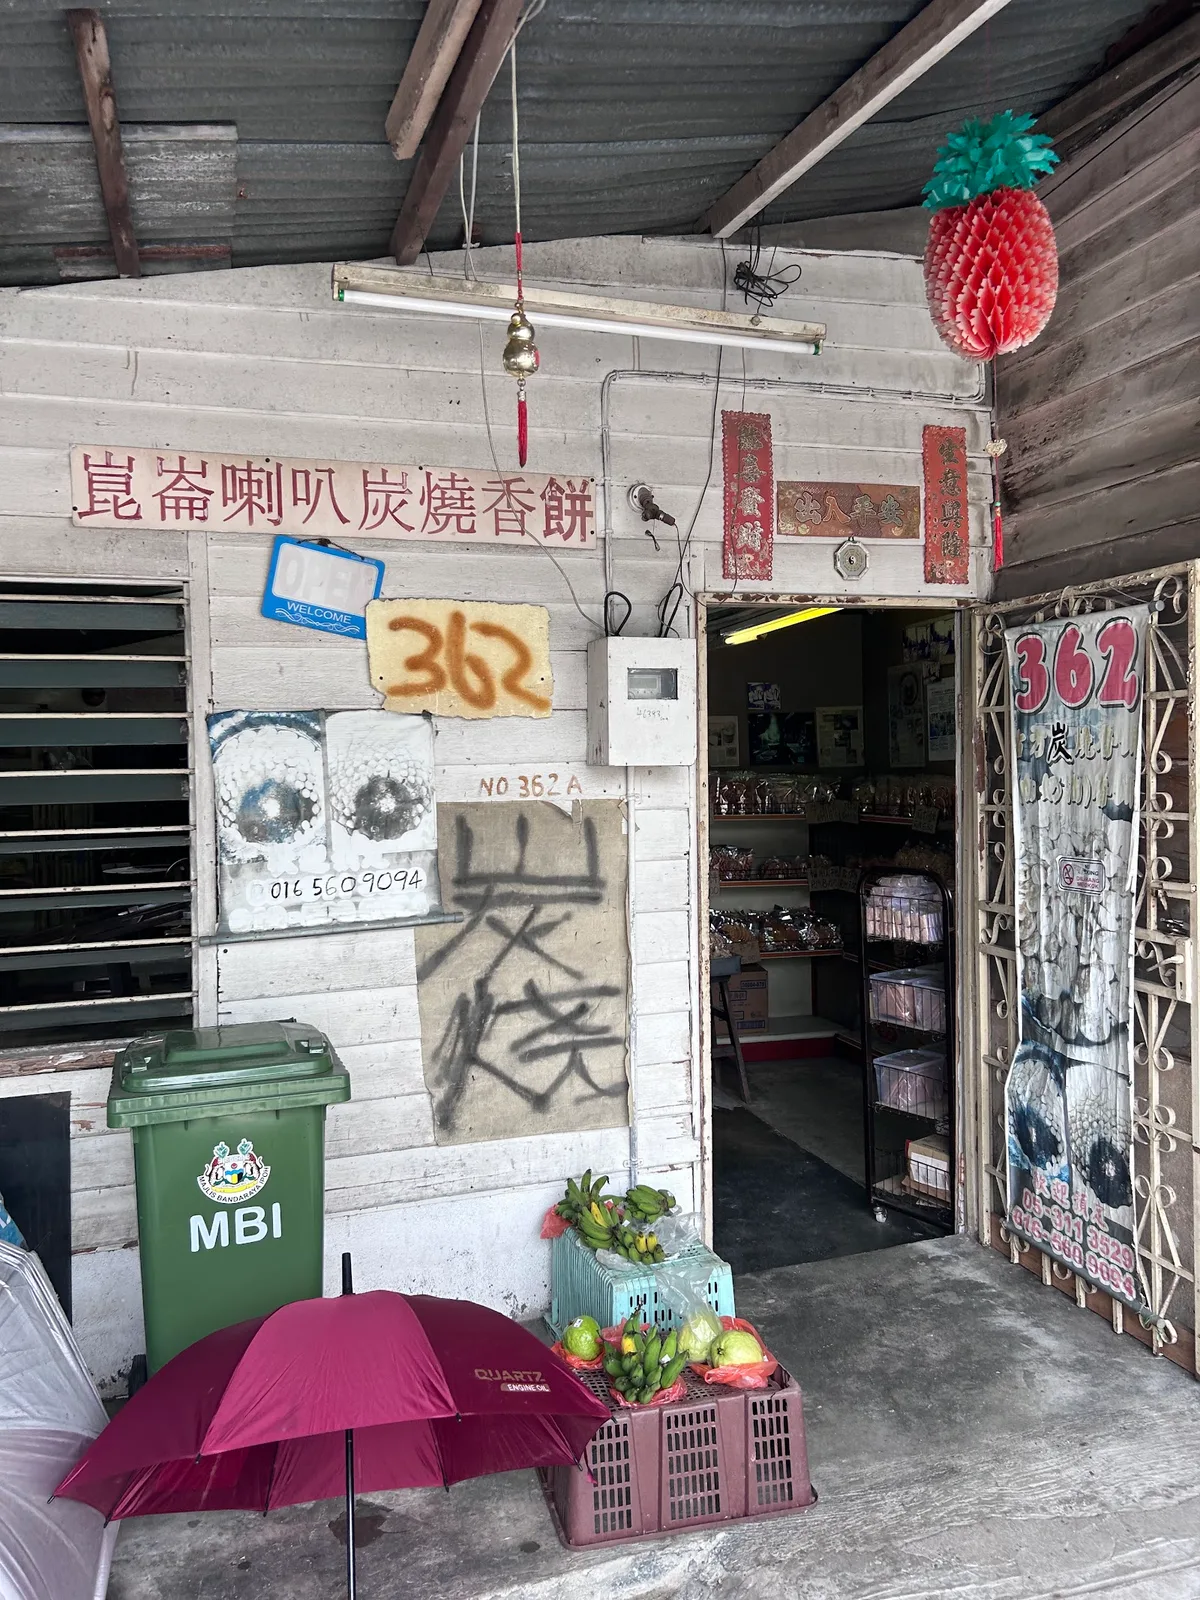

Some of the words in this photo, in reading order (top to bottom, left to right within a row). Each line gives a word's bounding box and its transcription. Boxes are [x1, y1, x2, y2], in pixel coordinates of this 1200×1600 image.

[78, 450, 594, 542] 崑崙喇叭炭燒香餅
[794, 491, 904, 528] 出入平安
[938, 437, 966, 558] 生意興隆
[287, 601, 352, 624] WELCOME
[388, 611, 551, 710] 362
[1014, 617, 1140, 716] 362
[480, 777, 509, 798] NO
[271, 879, 303, 899] 016
[199, 1176, 216, 1198] MAJLIS
[217, 1184, 261, 1203] BANDARAYA
[260, 1167, 269, 1184] IPOH
[190, 1202, 281, 1252] MBI
[1024, 1188, 1083, 1242] 05-311
[1088, 1227, 1133, 1271] 3529
[1087, 1252, 1135, 1299] 9094
[474, 1369, 546, 1382] QUARTZ
[507, 1383, 536, 1392] ENGINE
[536, 1383, 550, 1392] OIL
